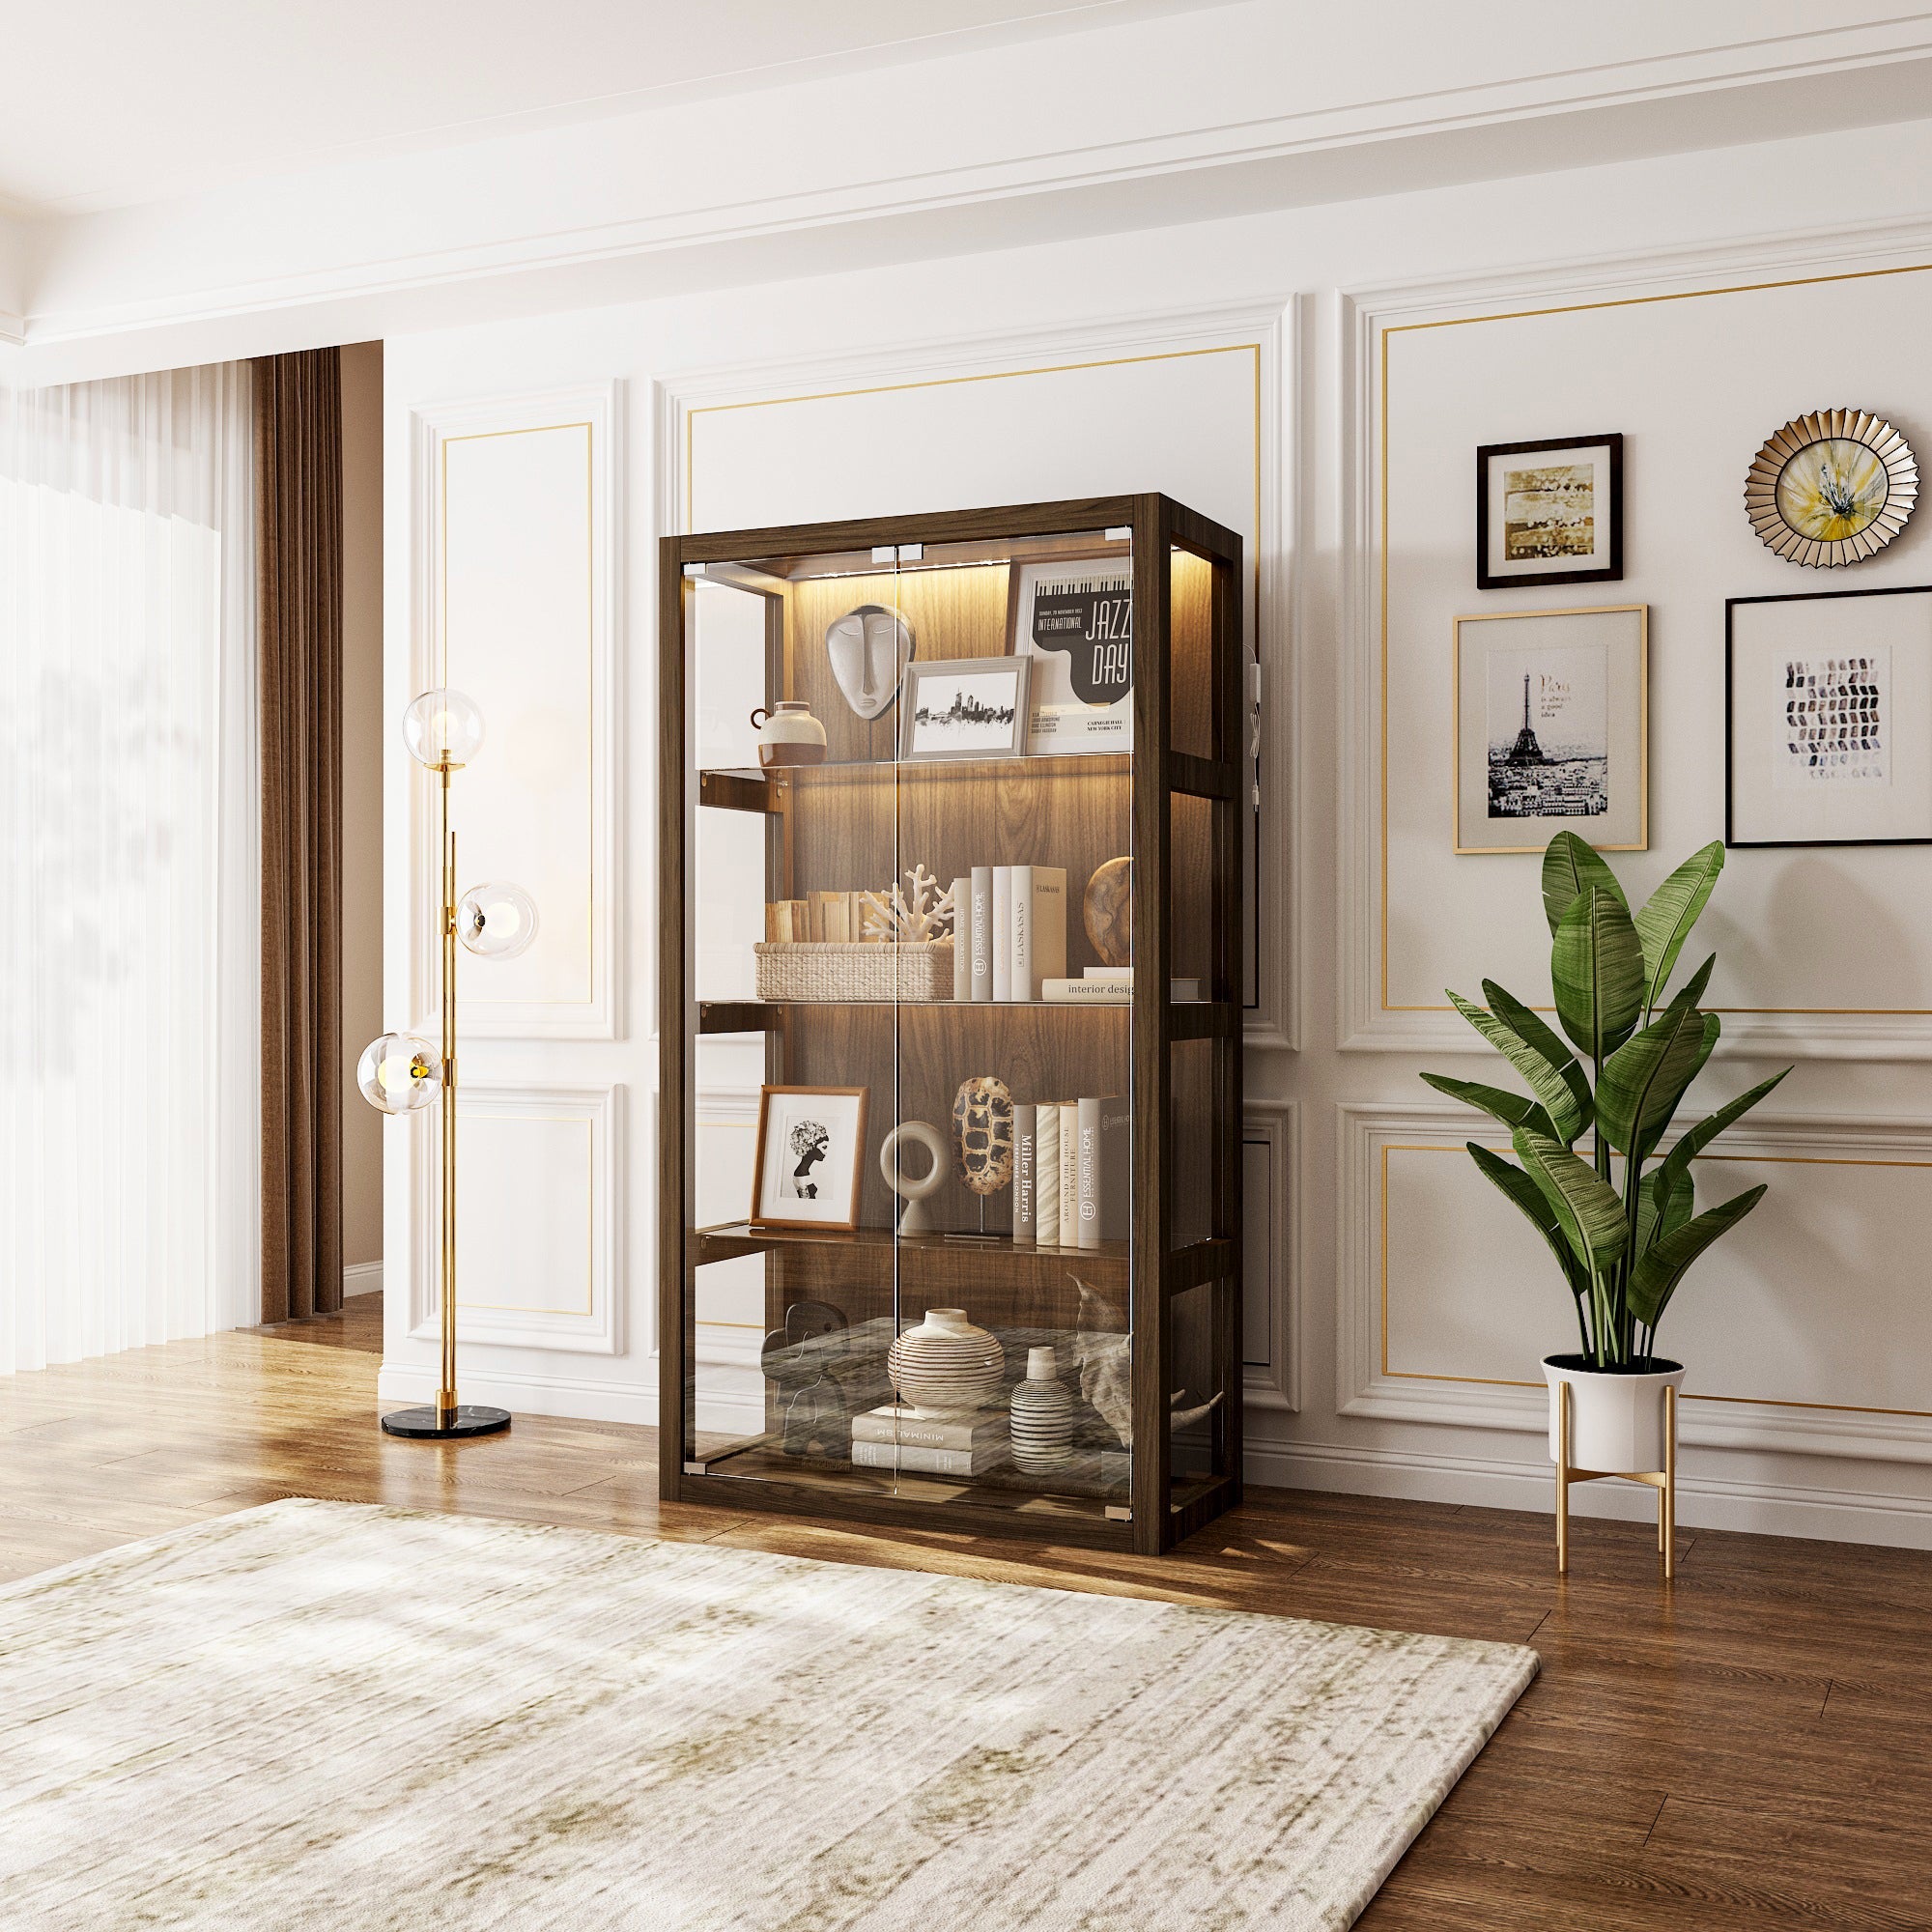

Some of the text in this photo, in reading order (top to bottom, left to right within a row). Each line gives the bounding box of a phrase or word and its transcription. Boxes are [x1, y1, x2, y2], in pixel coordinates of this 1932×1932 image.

[1037, 616, 1082, 631] INTERNATIONAL
[1085, 599, 1131, 640] JAZZ
[1092, 643, 1128, 684] DAY
[975, 892, 983, 955] ESSENTIAL HOME
[1067, 984, 1106, 994] interior
[1021, 1134, 1032, 1223] Miller Harris
[1083, 1126, 1092, 1198] ESSENTIAL HOME
[876, 1429, 944, 1441] MINIMALSM
